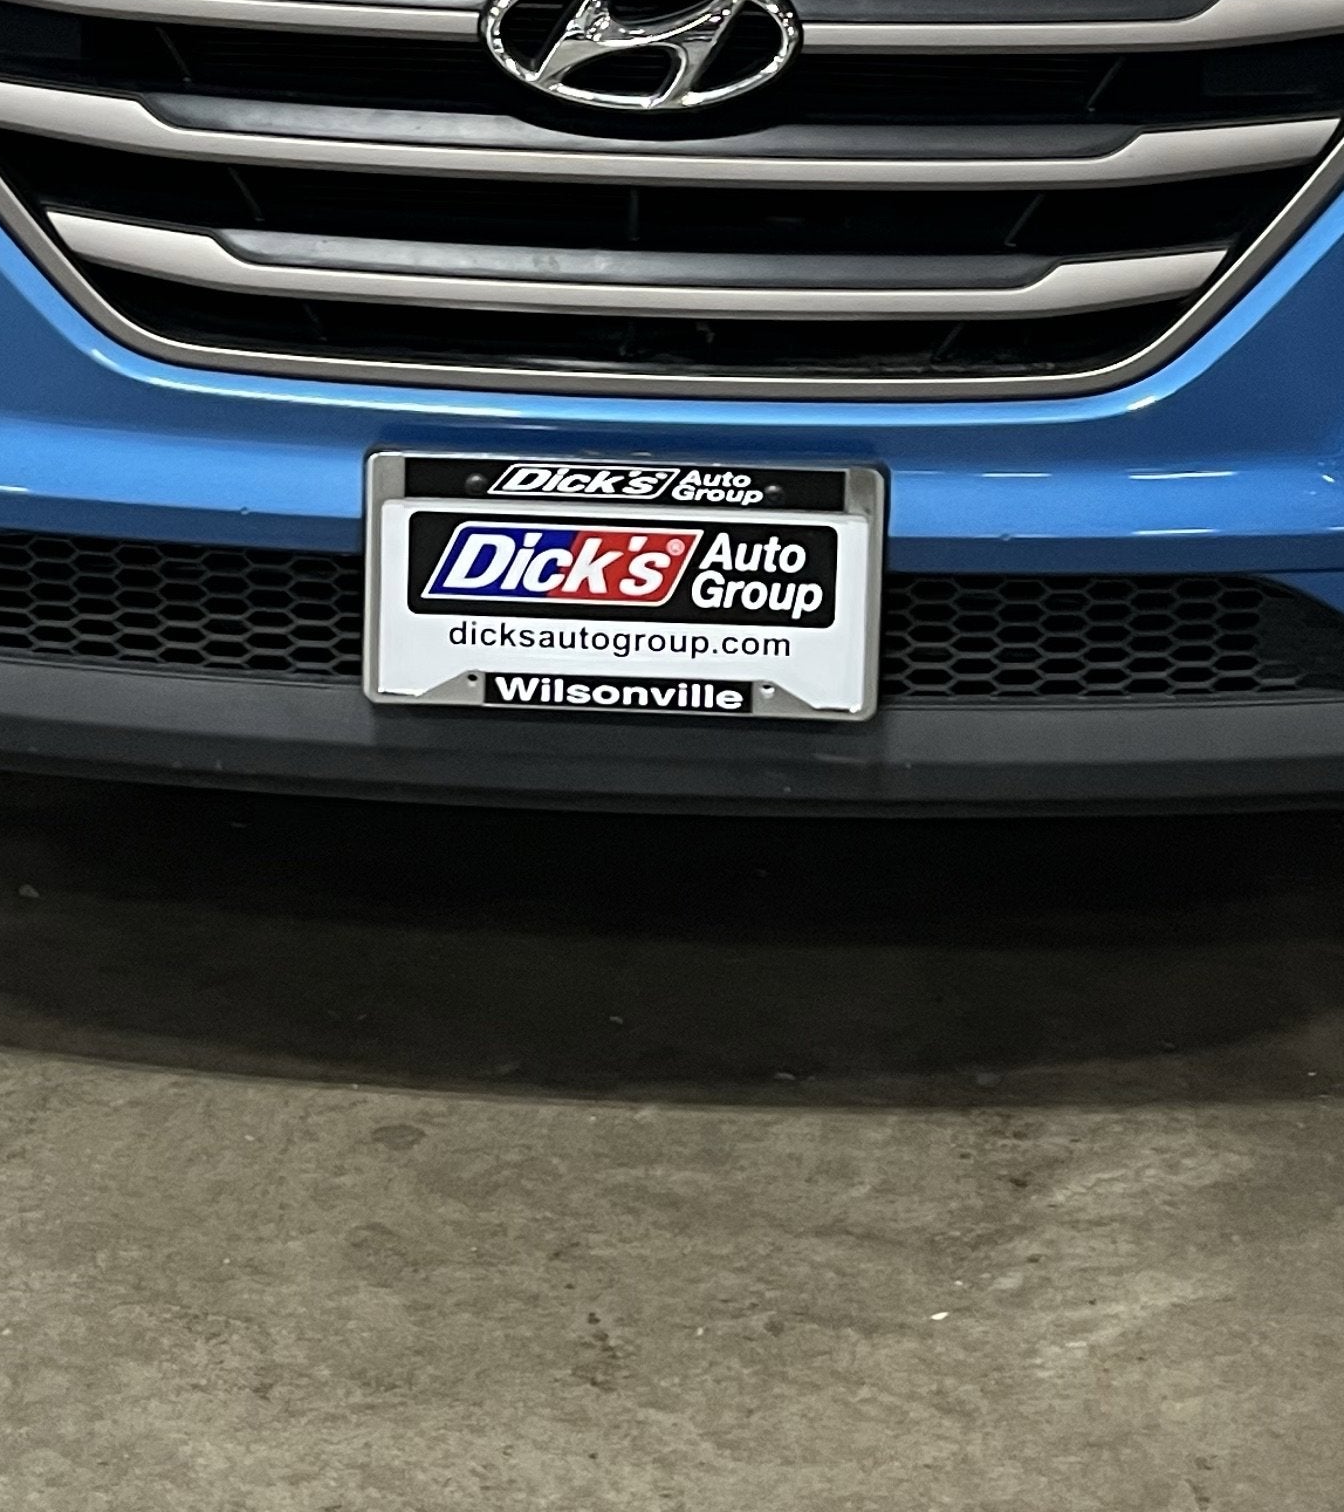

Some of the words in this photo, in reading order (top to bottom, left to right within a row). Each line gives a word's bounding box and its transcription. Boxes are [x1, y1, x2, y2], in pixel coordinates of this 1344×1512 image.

[671, 485, 764, 506] Group
[679, 469, 752, 488] Auto
[442, 531, 671, 597] Dick's
[698, 532, 807, 574] Auto
[691, 571, 823, 618] Group
[449, 621, 791, 658] dicksautogroup.com
[494, 676, 744, 710] Wilsonville
